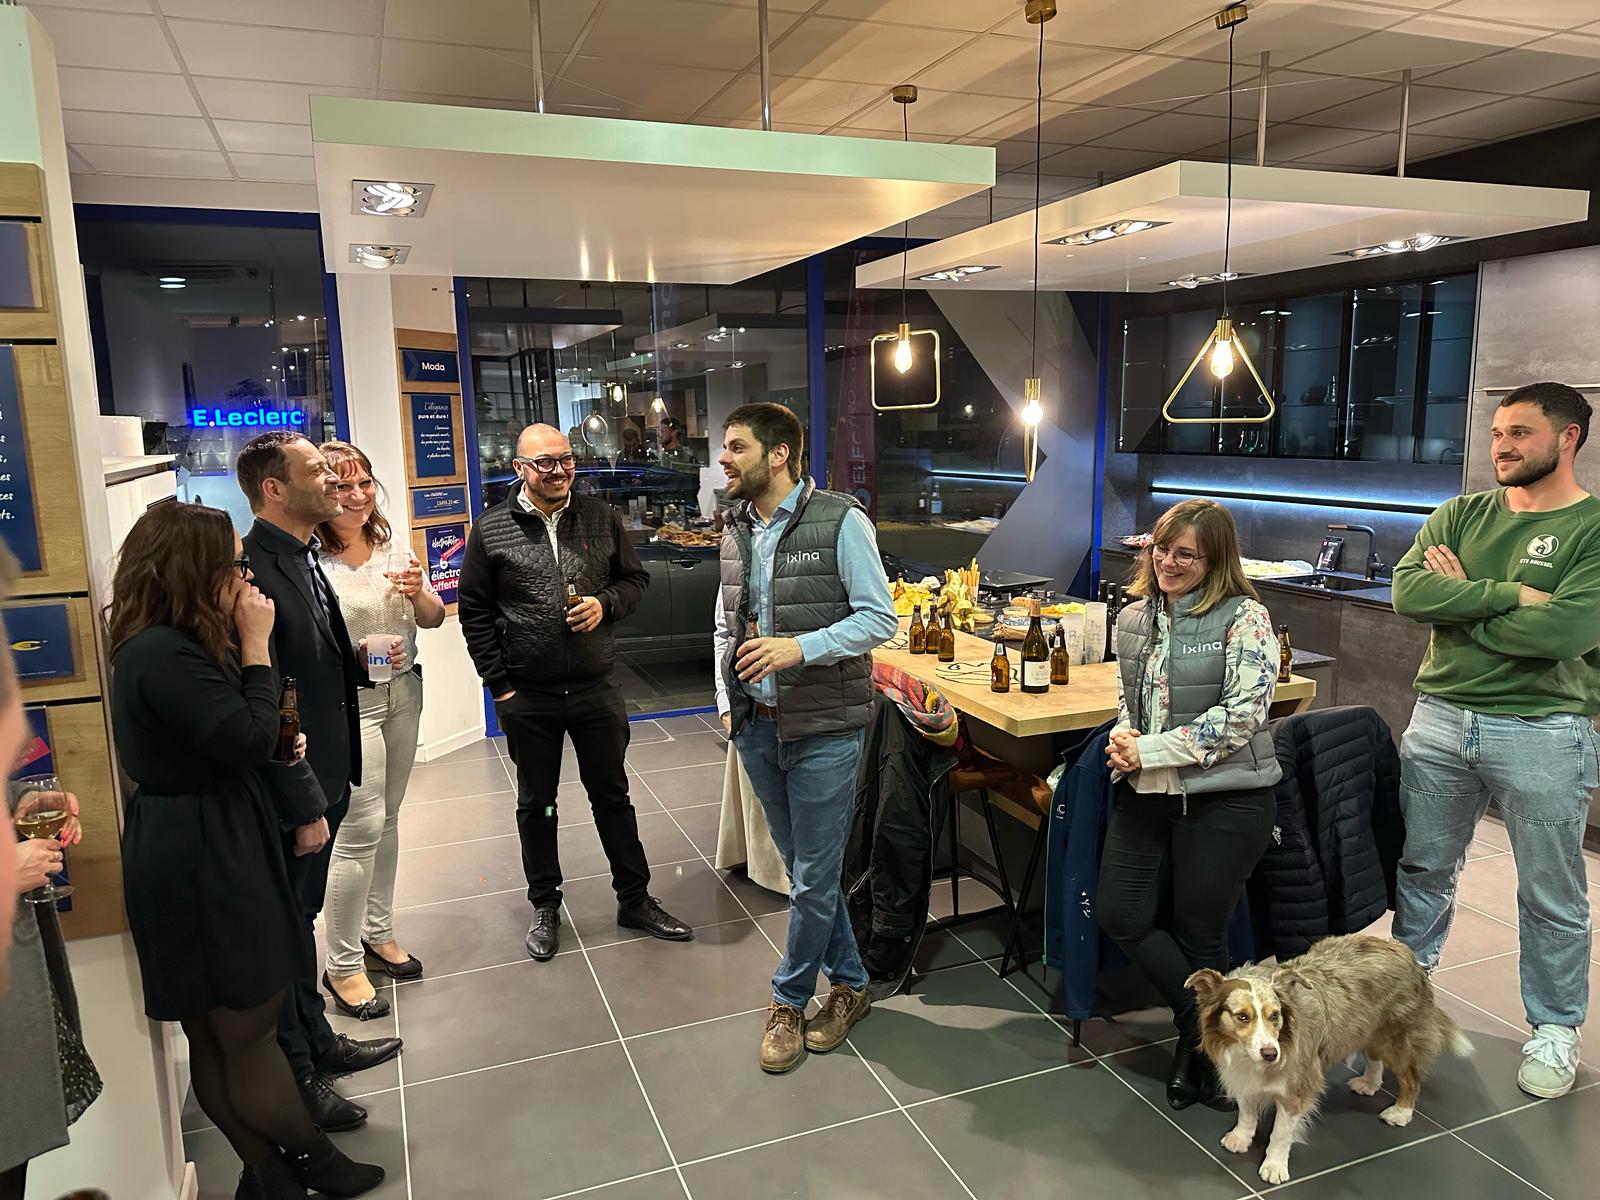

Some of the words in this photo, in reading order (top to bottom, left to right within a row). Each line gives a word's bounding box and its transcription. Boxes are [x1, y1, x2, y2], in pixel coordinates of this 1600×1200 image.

[421, 361, 445, 371] Moda
[192, 408, 302, 427] E.Leclerc
[786, 550, 820, 564] ixina
[431, 568, 461, 582] électro
[433, 579, 459, 592] offerts
[1182, 640, 1223, 655] ixina
